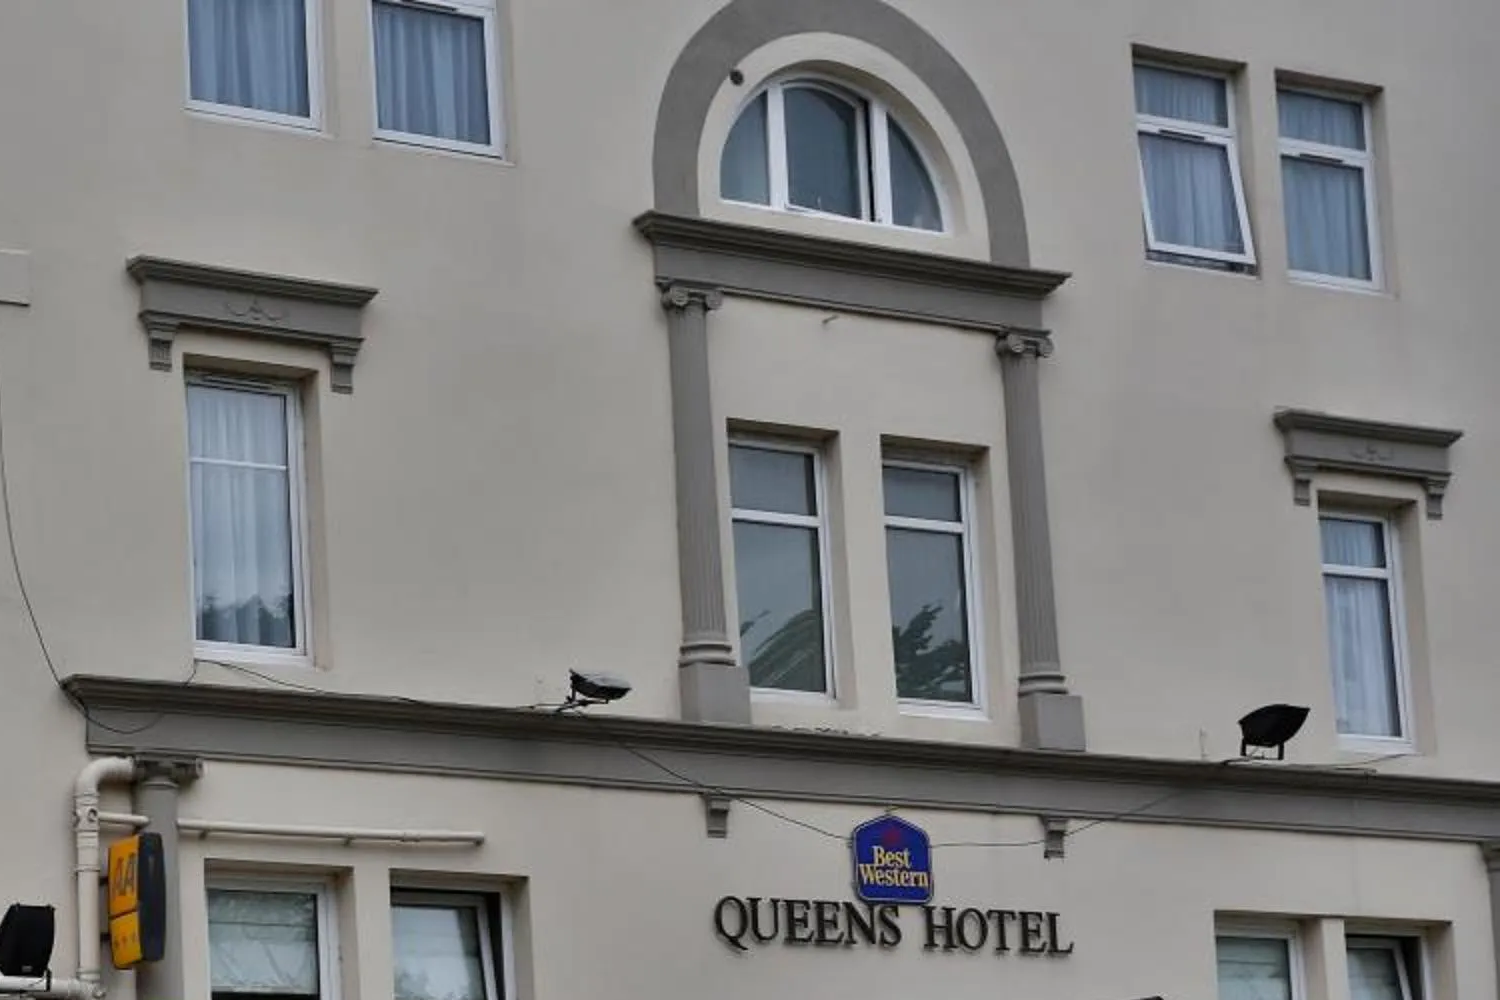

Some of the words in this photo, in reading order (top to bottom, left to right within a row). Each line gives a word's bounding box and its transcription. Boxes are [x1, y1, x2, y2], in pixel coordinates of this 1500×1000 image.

[871, 845, 912, 868] Best
[858, 863, 929, 887] Western
[713, 895, 902, 951] QUEENS
[921, 904, 1075, 954] HOTEL
